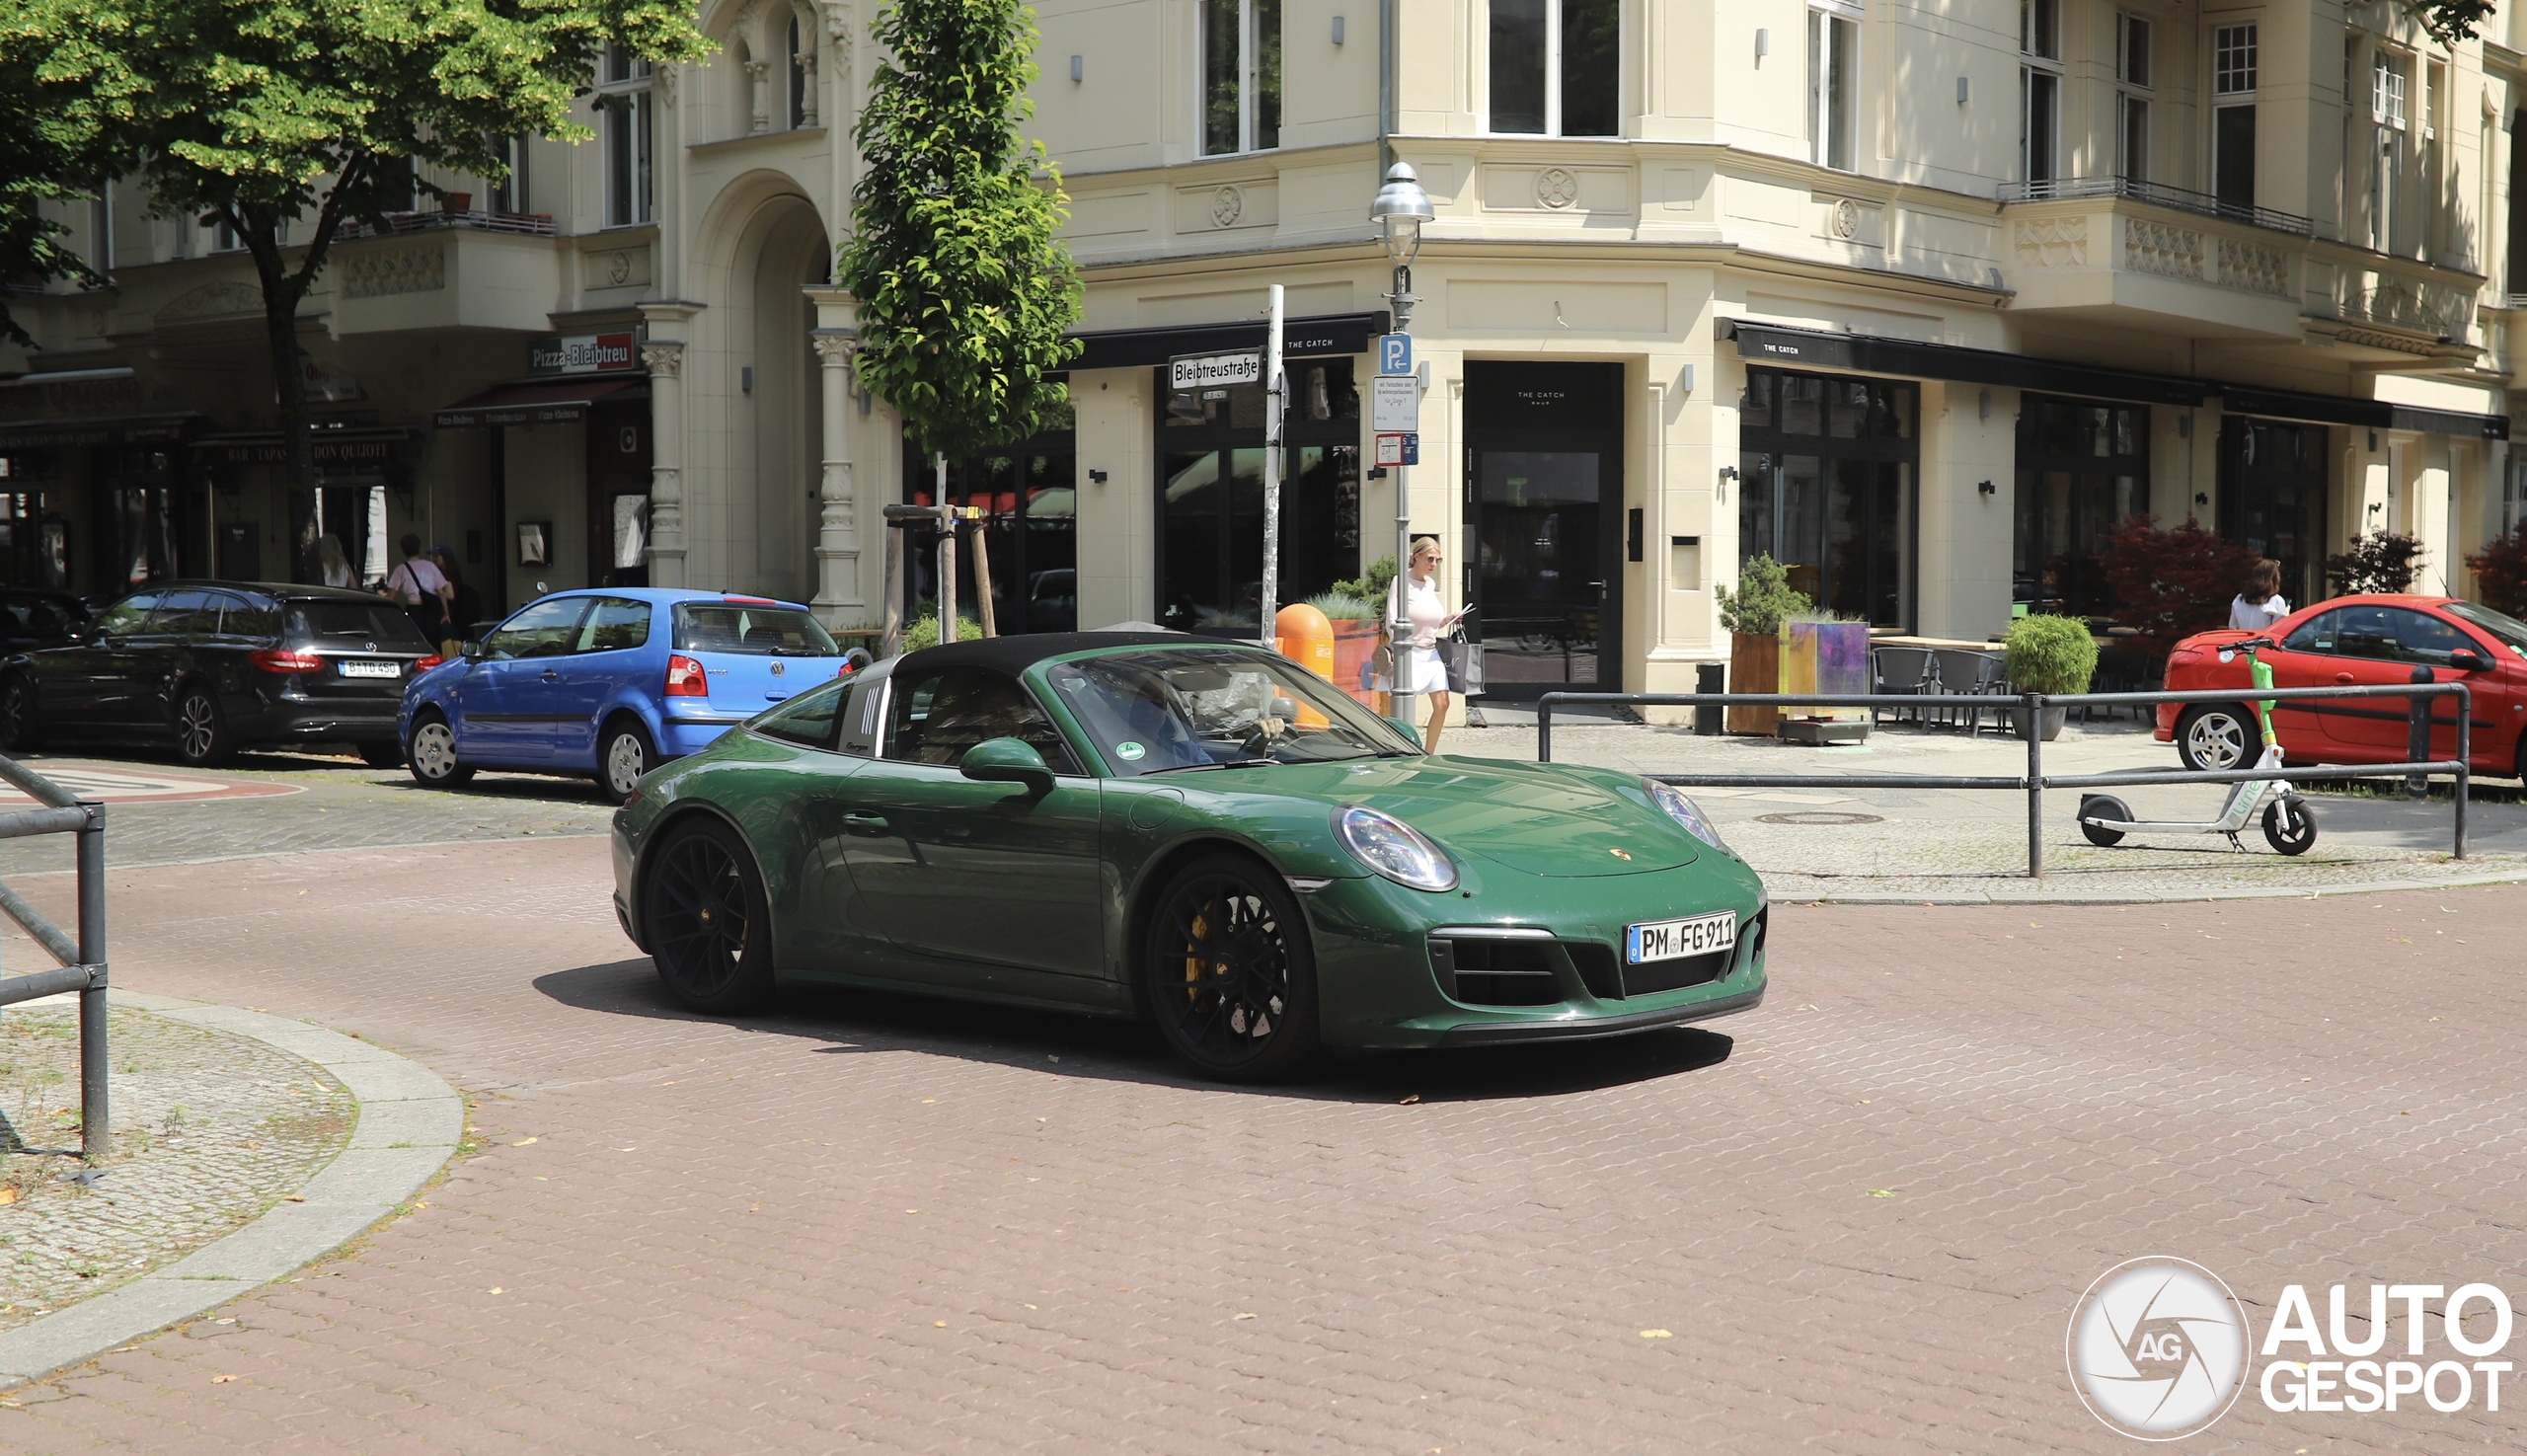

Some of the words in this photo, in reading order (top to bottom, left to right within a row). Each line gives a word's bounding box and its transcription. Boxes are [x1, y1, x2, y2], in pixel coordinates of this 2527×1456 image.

[1306, 339, 1334, 347] CATCH
[1387, 340, 1405, 370] P
[1763, 344, 1777, 352] THE
[1778, 345, 1800, 354] CATCH
[533, 344, 628, 368] Pizza-Bleibtreu
[1175, 357, 1258, 381] Bleibtreustraße
[228, 449, 249, 462] BAR
[259, 446, 287, 461] TAPAS
[314, 444, 337, 460] DON
[341, 443, 388, 461] QUIJOTE
[2232, 780, 2261, 815] Lime
[1642, 928, 1668, 958] PM
[1680, 923, 1703, 953] FG
[1706, 917, 1733, 948] 911
